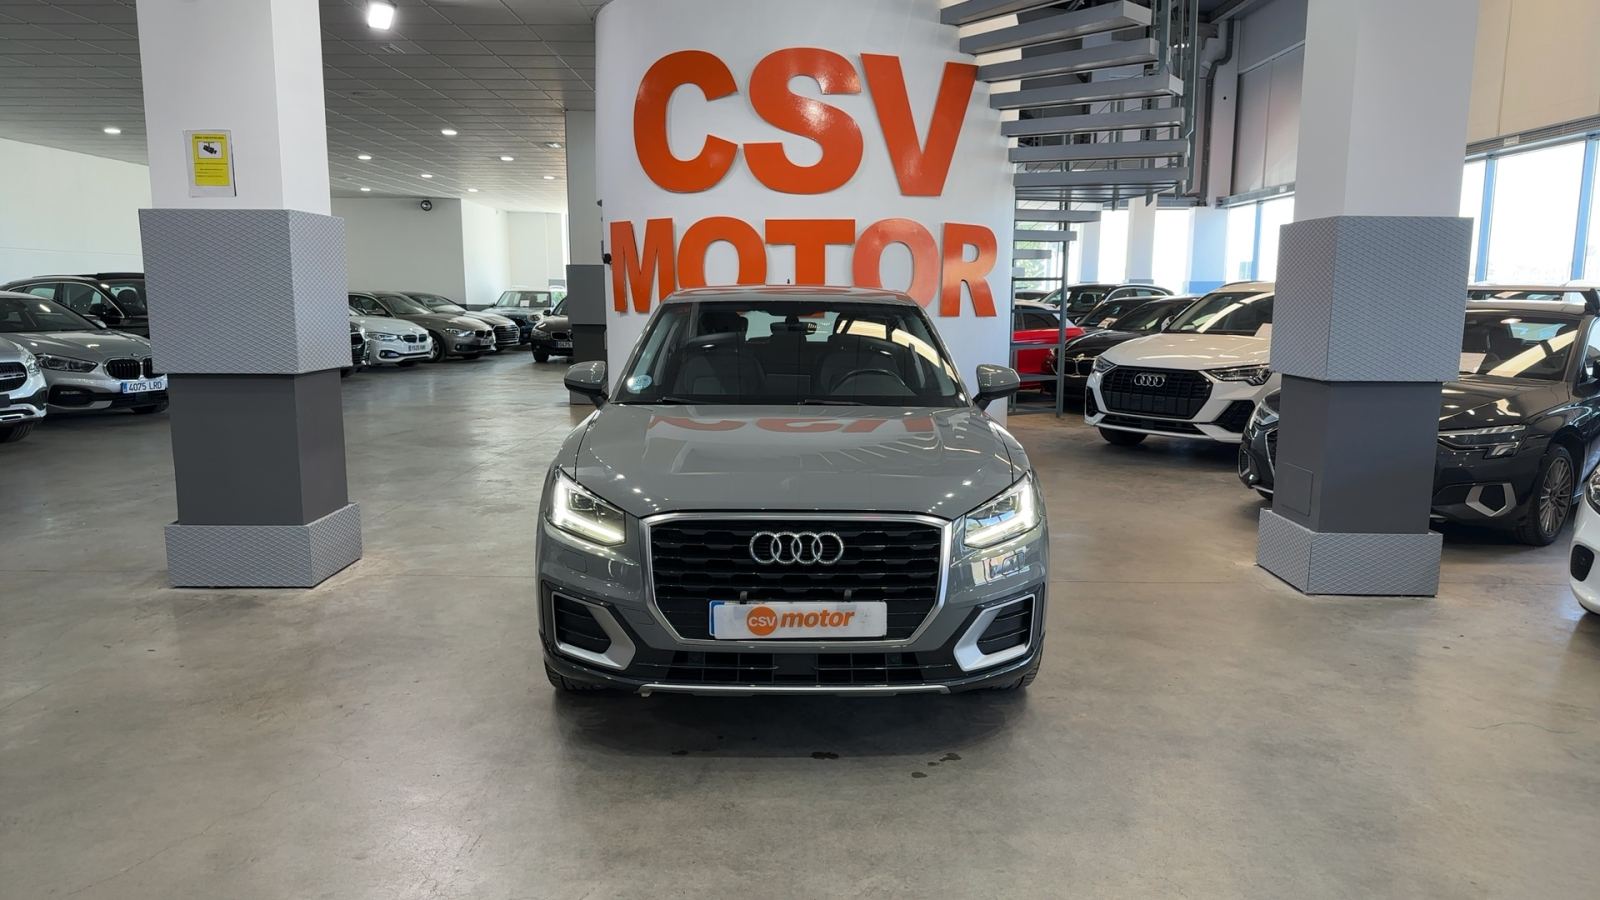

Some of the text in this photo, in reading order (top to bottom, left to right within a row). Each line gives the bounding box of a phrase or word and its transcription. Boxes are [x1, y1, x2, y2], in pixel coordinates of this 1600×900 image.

[633, 47, 977, 196] CSV
[610, 215, 998, 317] MOTOR
[129, 383, 147, 391] 4075
[748, 609, 855, 628] CSV motor
